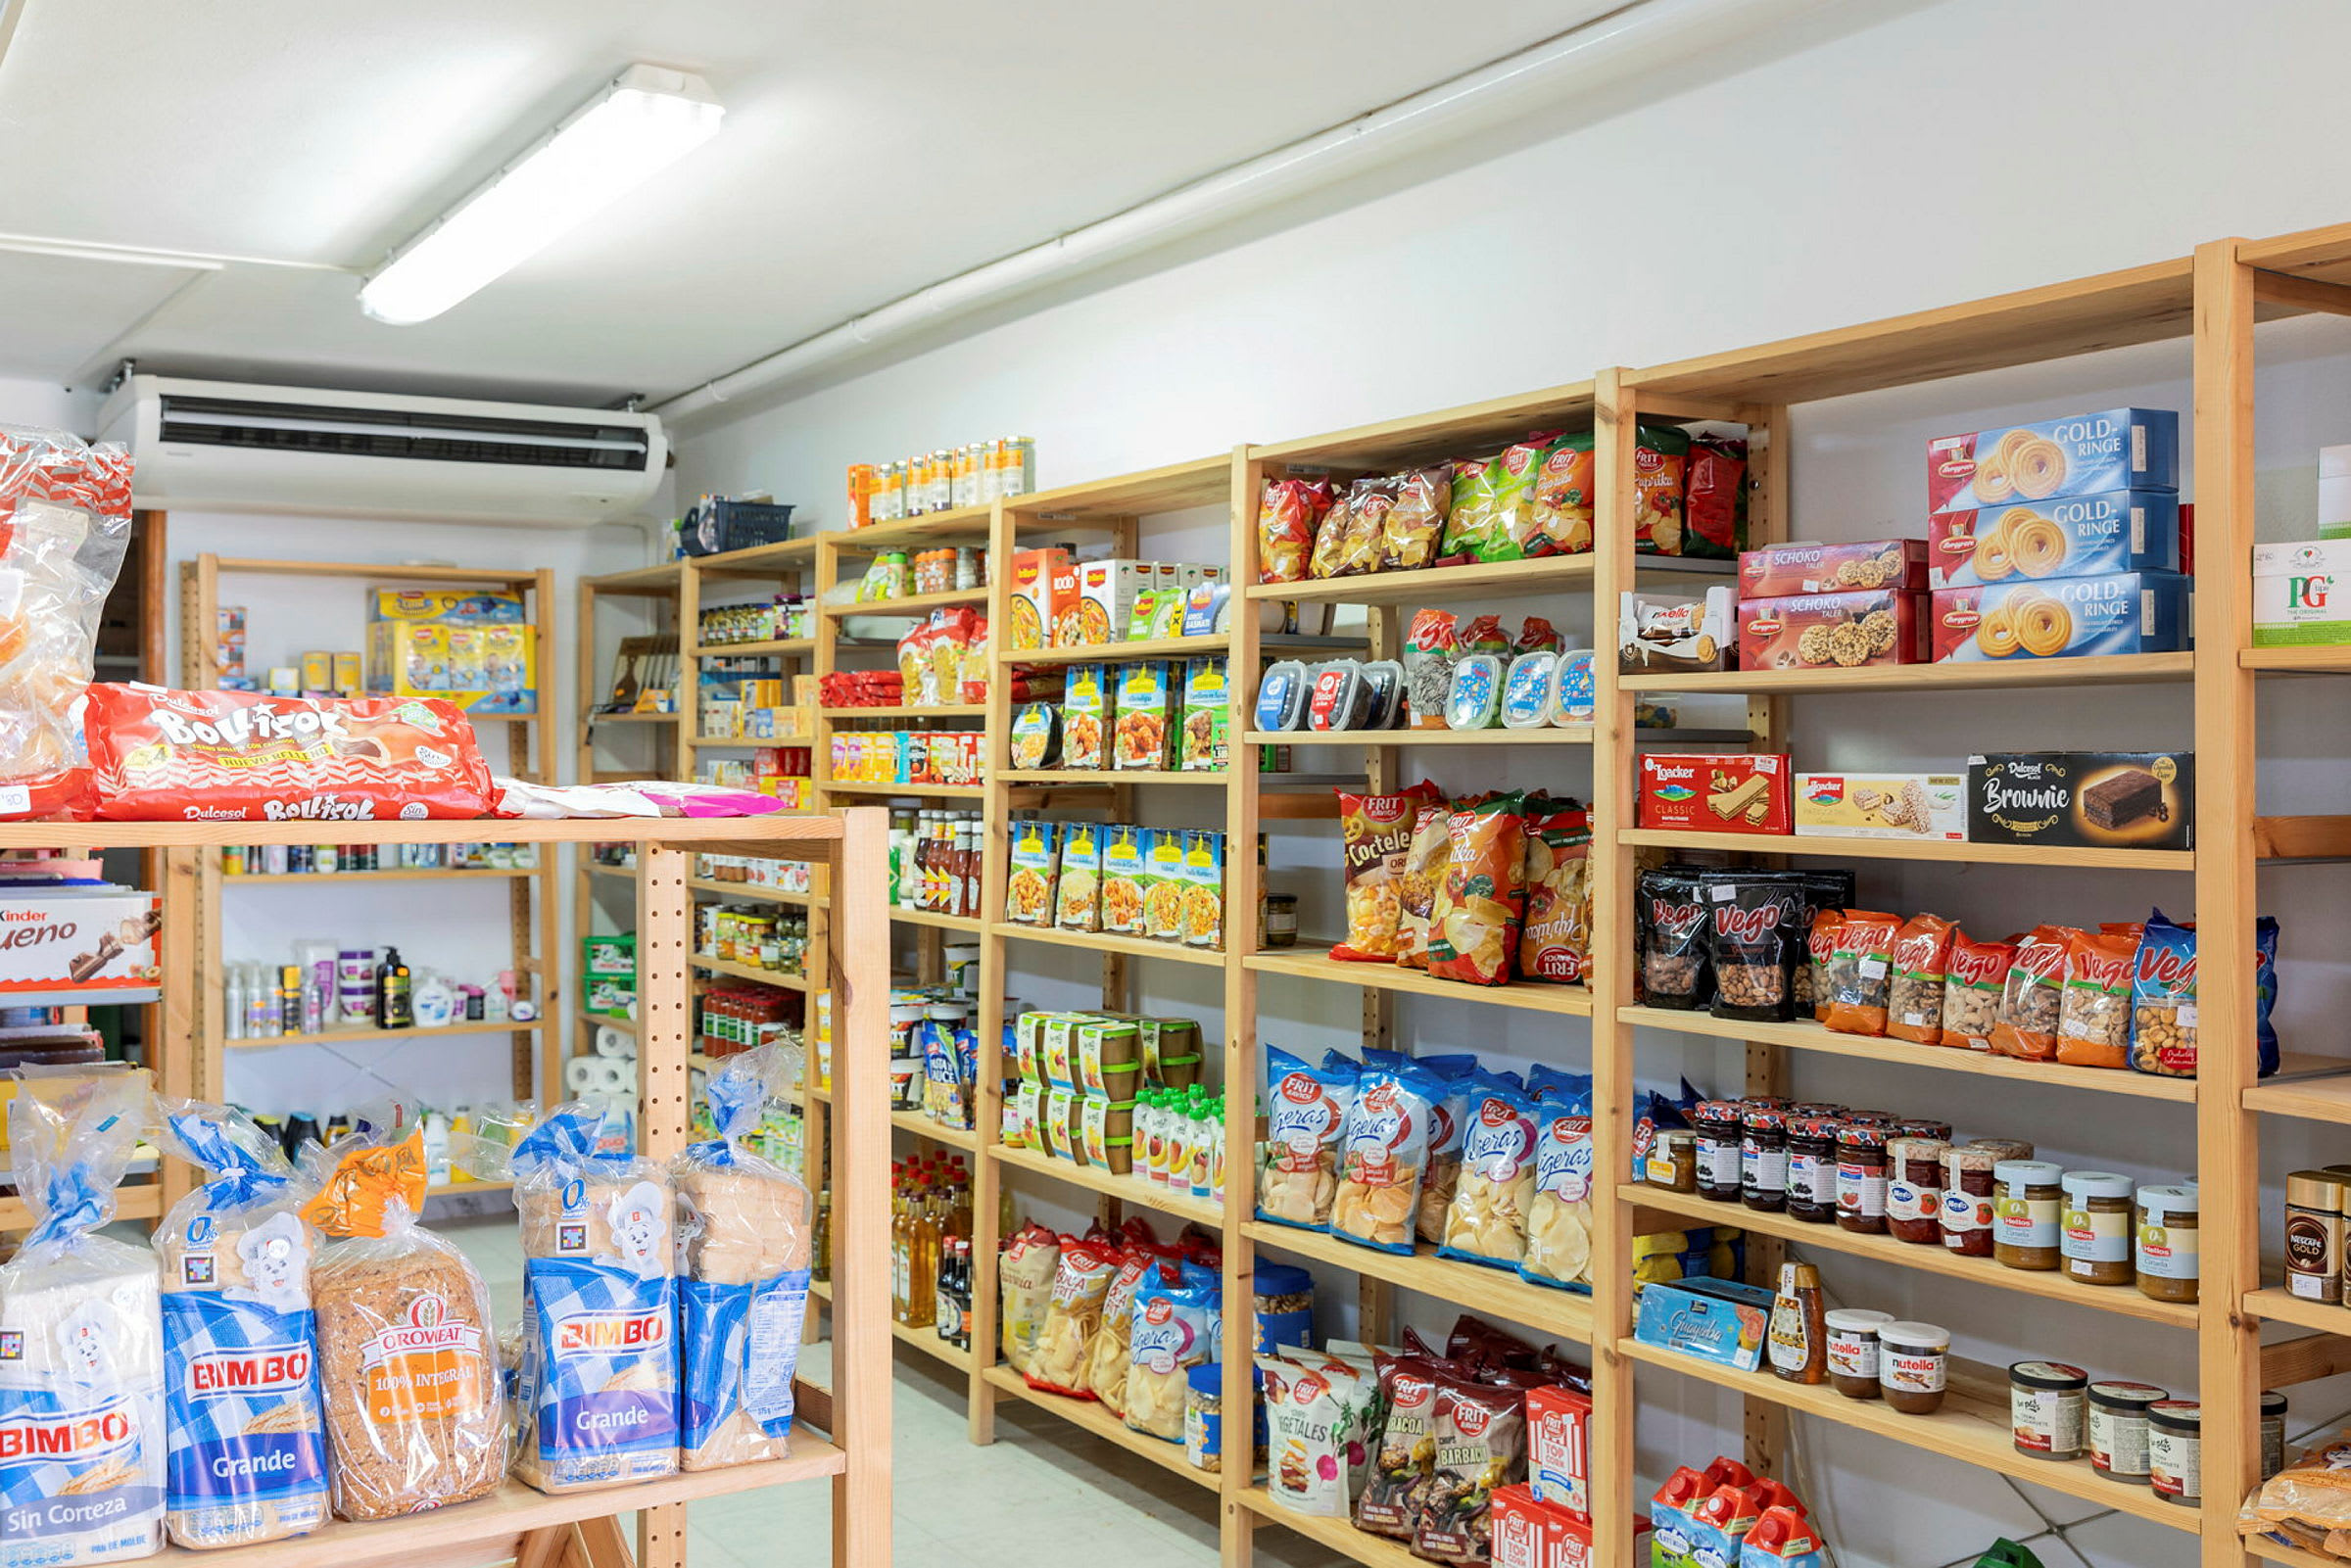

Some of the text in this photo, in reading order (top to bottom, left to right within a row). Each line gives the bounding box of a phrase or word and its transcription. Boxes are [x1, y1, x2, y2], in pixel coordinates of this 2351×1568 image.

[2053, 419, 2117, 442] GOLD-
[2078, 438, 2121, 456] RINGE
[1552, 453, 1573, 464] FRIT
[1637, 451, 1658, 463] FRIT
[2053, 500, 2117, 523] GOLD-
[2078, 519, 2120, 538] RINGE
[1774, 550, 1821, 565] SCHOKO
[2061, 581, 2126, 601] GOLD-
[2288, 576, 2328, 608] PG
[1791, 596, 1842, 611] SCHOKO
[1822, 608, 1843, 618] TALER
[2085, 600, 2128, 616] RINGE
[149, 692, 219, 716] Dulcesol
[1654, 763, 1695, 781] Loacker
[2008, 762, 2041, 779] Dulcesol
[1811, 780, 1843, 792] Loacker
[1983, 778, 2069, 813] Brownie
[1367, 797, 1399, 810] FRIT
[1655, 805, 1695, 816] CLASSIC
[183, 805, 246, 822] Dulcesol
[1349, 828, 1410, 867] Coctele
[1653, 898, 1703, 935] Vego
[1715, 903, 1781, 943] Vego
[0, 922, 77, 950] ueno
[1836, 926, 1888, 956] Vego
[1808, 931, 1833, 965] eg
[1895, 939, 1932, 974] Vego
[1544, 962, 1575, 975] FRIT
[1947, 947, 2001, 985] Vego
[2080, 948, 2135, 991] Vego
[2139, 946, 2196, 994] Veg
[1286, 1077, 1318, 1094] FRIT
[1271, 1099, 1326, 1141] geras
[1556, 1119, 1591, 1131] FRIT
[2005, 1217, 2031, 1226] Helios
[2068, 1230, 2094, 1240] Helios
[2290, 1234, 2323, 1248] NESCAFÉ
[2143, 1246, 2170, 1256] Helios
[2293, 1245, 2320, 1256] GOLD
[561, 1316, 663, 1349] BIMBO
[1670, 1309, 1723, 1344] Guayaba
[382, 1327, 462, 1350] OROWEAT
[193, 1353, 308, 1390] BIMBO
[1892, 1357, 1935, 1371] nutella
[376, 1365, 472, 1391] 100% INTEGRAL
[1296, 1382, 1319, 1395] FRIT
[576, 1405, 648, 1432] Grande
[1458, 1404, 1485, 1423] FRIT
[0, 1411, 128, 1458] BIMBO
[1387, 1416, 1424, 1436] BACOA
[1545, 1444, 1564, 1458] TOP
[213, 1449, 296, 1478] Grande
[8, 1497, 127, 1532] Sin Corteza
[1508, 1543, 1526, 1557] TOP
